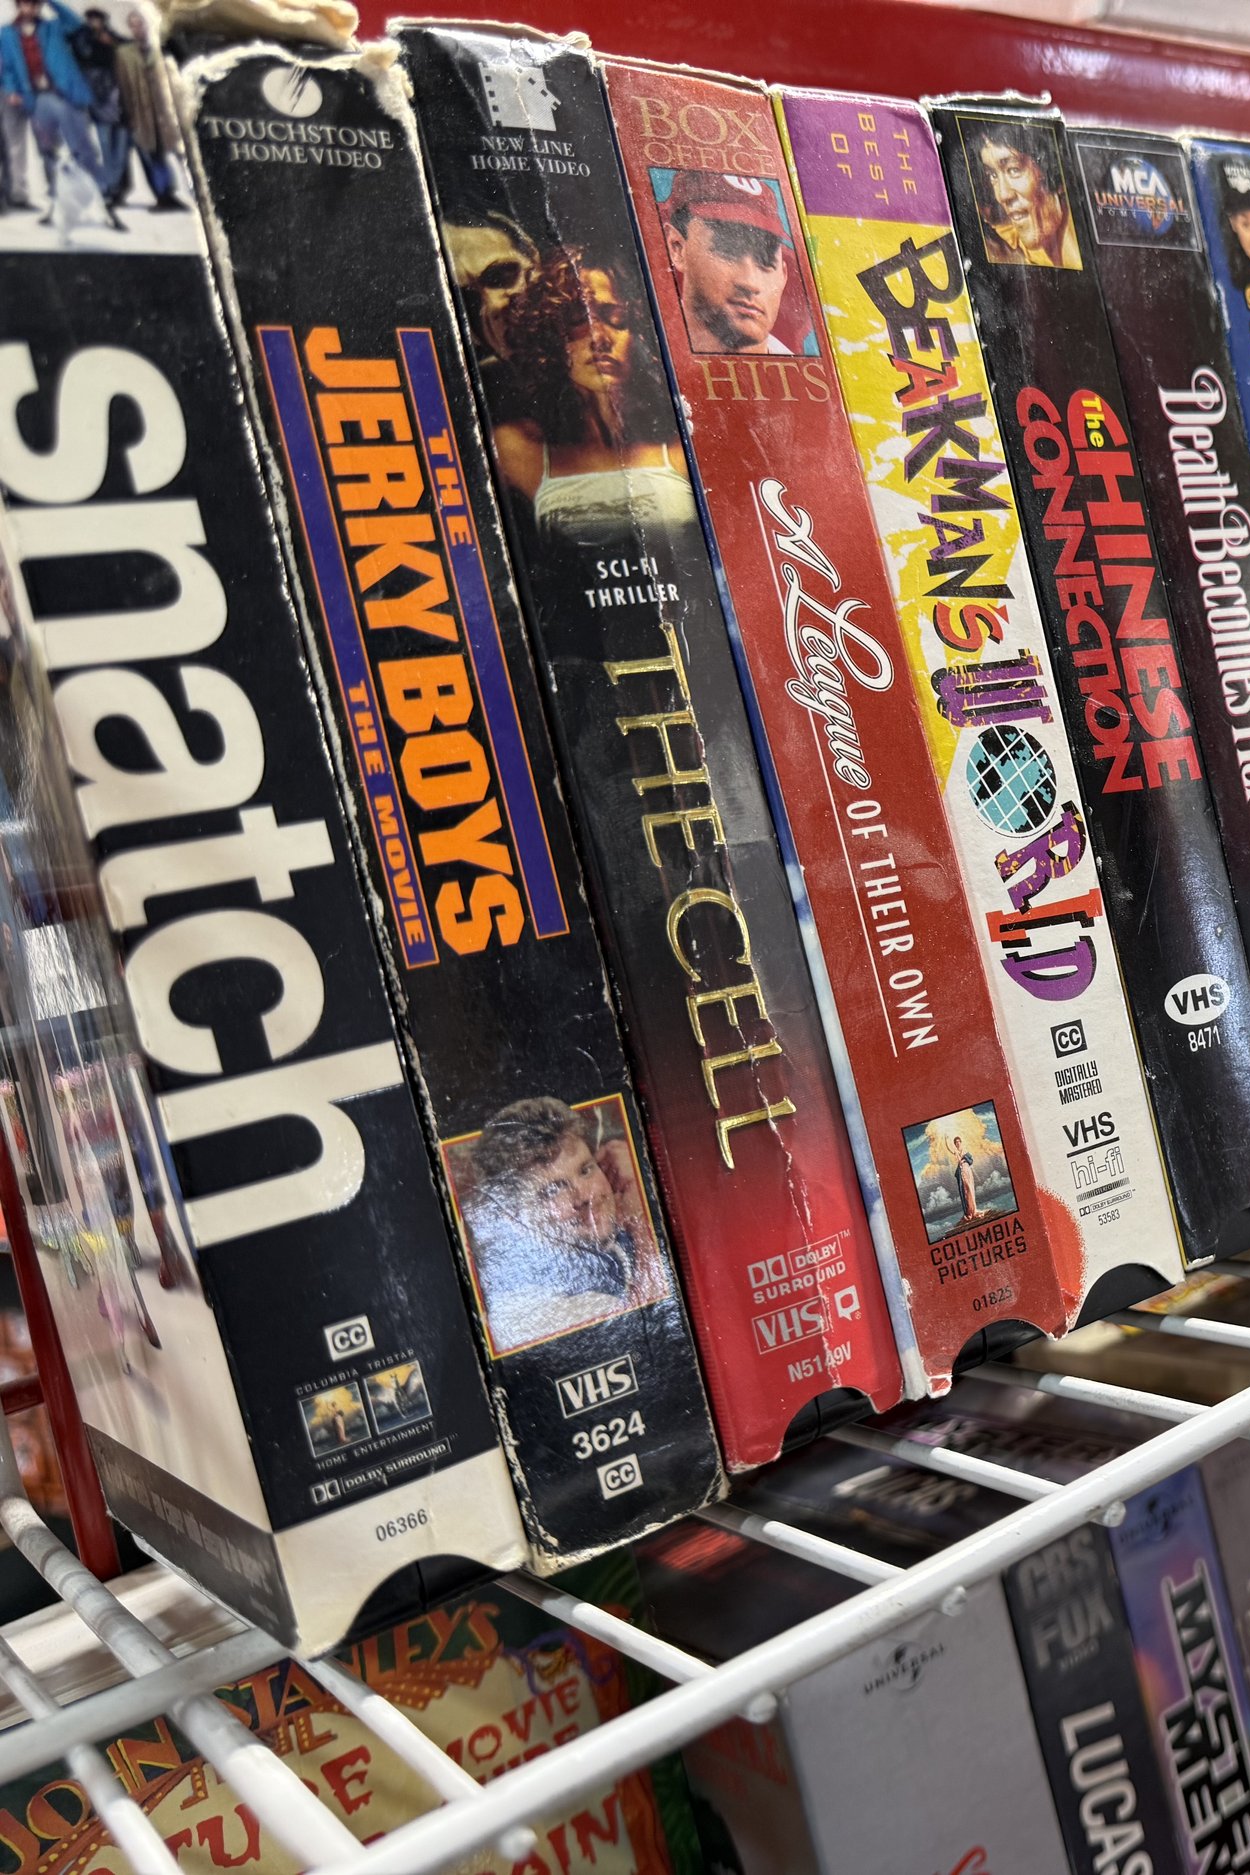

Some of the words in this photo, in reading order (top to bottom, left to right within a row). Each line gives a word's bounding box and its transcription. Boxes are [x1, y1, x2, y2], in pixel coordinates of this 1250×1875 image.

[204, 117, 394, 150] TOUCHSTONE
[482, 136, 531, 155] NEW
[533, 140, 576, 158] LINE
[631, 96, 773, 151] BOX
[231, 141, 306, 162] HOME
[306, 147, 383, 170] VIDEO
[472, 154, 531, 174] HOME
[534, 158, 591, 178] VIDEO
[643, 141, 776, 175] OFFICE
[831, 132, 852, 180] OF
[857, 112, 889, 204] BEST
[893, 130, 917, 195] THE
[1094, 191, 1188, 214] UNIVERSAL
[1109, 165, 1168, 197] MCA
[694, 358, 832, 403] HITS
[1080, 396, 1105, 449] The
[1158, 366, 1240, 516] Death
[304, 327, 459, 643] JERKY
[424, 427, 474, 548] THE
[760, 478, 840, 592] A
[596, 557, 659, 580] SCI-FI
[1016, 386, 1143, 794] CONNECTION
[1067, 388, 1202, 789] CHINESE
[584, 583, 680, 609] THRILLER
[783, 562, 895, 791] League
[0, 341, 404, 1248] snatch
[346, 679, 382, 777] THE
[371, 793, 427, 948] MOVIE
[379, 654, 525, 956] BOYS
[846, 799, 888, 841] OF
[603, 621, 723, 868] THE
[667, 888, 797, 1170] CELL
[860, 857, 903, 955] THEIR
[889, 968, 940, 1052] OWN
[1169, 978, 1228, 1018] VHS
[1054, 1024, 1084, 1053] CC
[1188, 1024, 1222, 1054] 8471
[1055, 1060, 1098, 1087] DIGITALLY
[1058, 1078, 1103, 1106] MASTERED
[1063, 1111, 1116, 1148] VHS
[1070, 1146, 1126, 1189] hi-fi
[1097, 1208, 1121, 1226] 53583
[794, 1240, 838, 1269] DOLBY
[930, 1217, 1025, 1267] COLUMBIA
[938, 1235, 1028, 1285] PICTURES
[753, 1260, 847, 1305] SURROUND
[330, 1320, 371, 1356] CC
[755, 1298, 826, 1350] VHS
[296, 1367, 359, 1397] COLUMBIA
[366, 1347, 416, 1371] TRISTAR
[560, 1358, 634, 1412] VHS
[787, 1340, 853, 1383] N5149V
[316, 1451, 348, 1472] HOME
[352, 1419, 436, 1459] ENTERTAINMENT
[572, 1410, 646, 1460] 3624
[344, 1465, 386, 1490] DOLBY
[385, 1442, 448, 1473] SURROUND
[602, 1459, 638, 1494] CC
[375, 1508, 429, 1543] 06366
[1030, 1585, 1115, 1670] FOX
